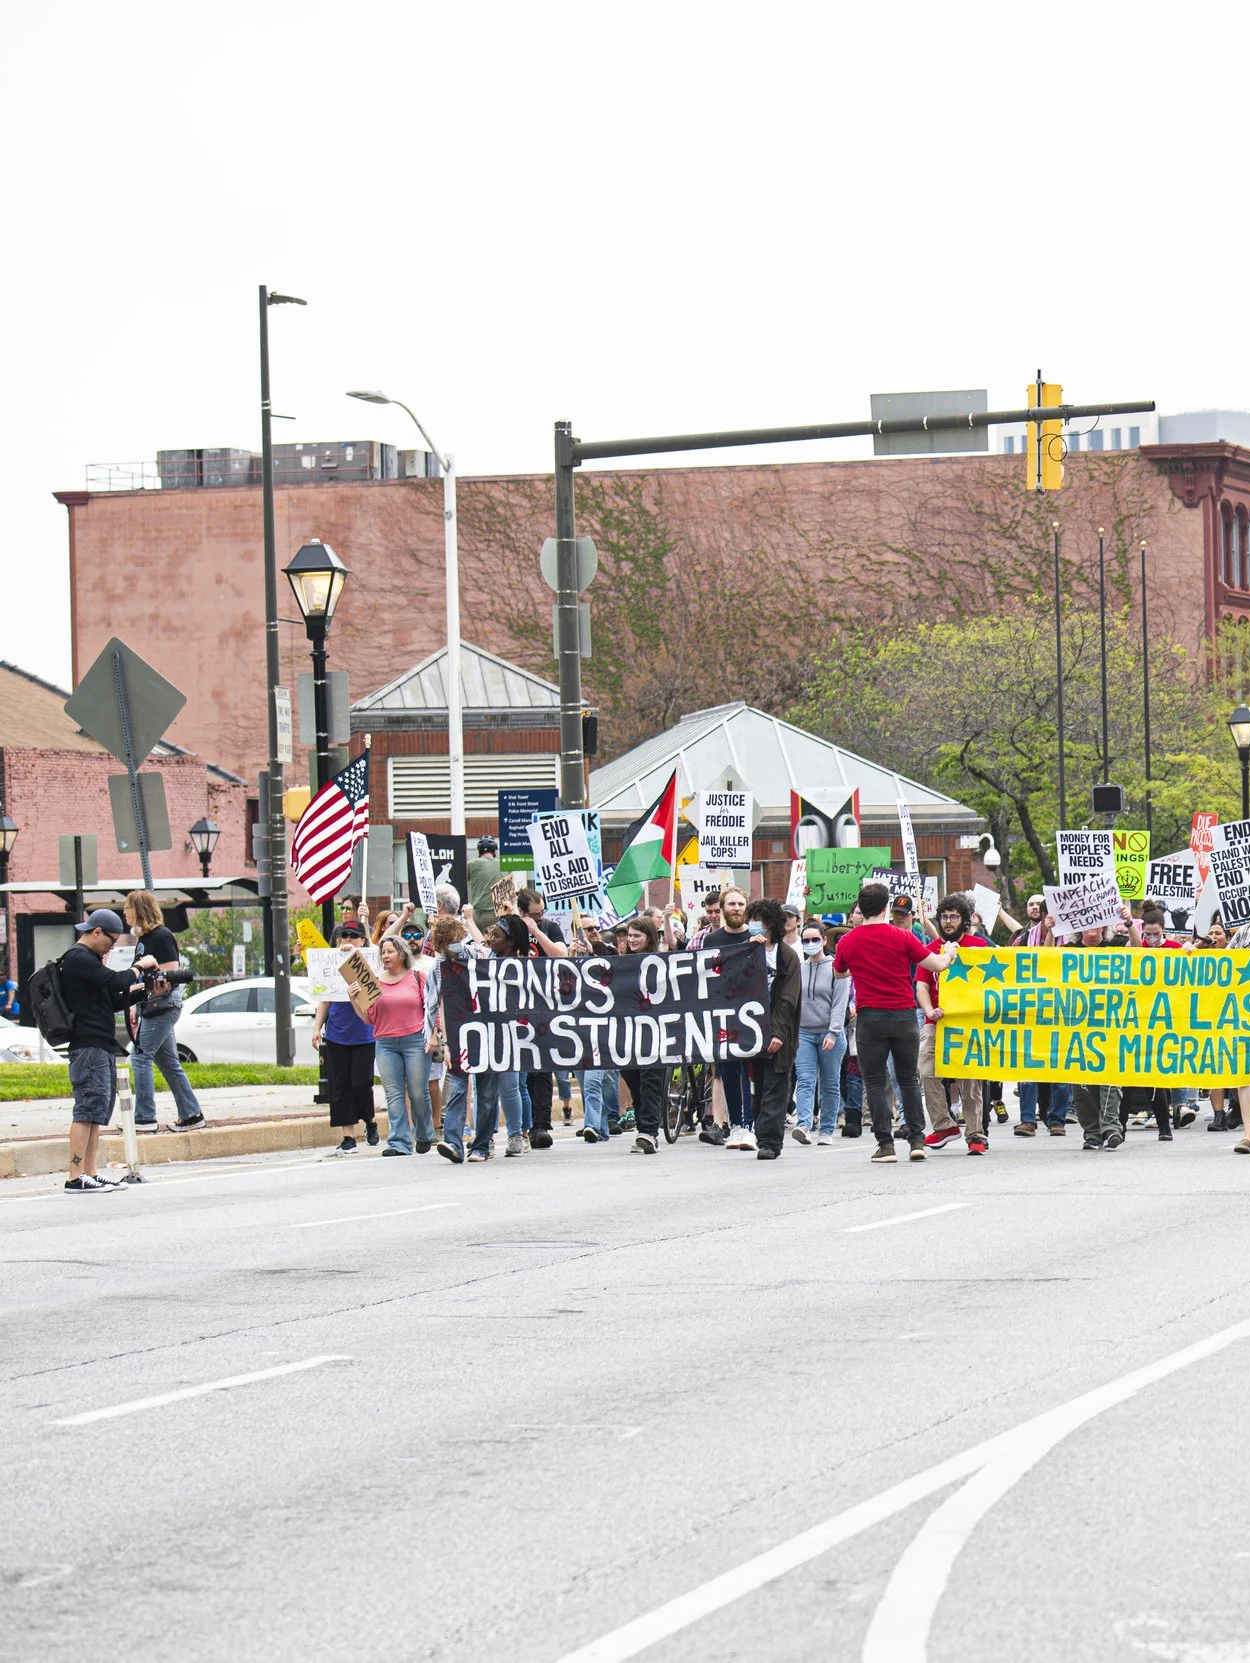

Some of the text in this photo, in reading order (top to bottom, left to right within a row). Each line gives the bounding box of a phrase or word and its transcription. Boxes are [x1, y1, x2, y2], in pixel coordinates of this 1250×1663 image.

[706, 794, 745, 806] JUSTICE
[720, 806, 729, 814] for
[541, 819, 570, 841] END
[705, 815, 745, 827] FREDDIE
[549, 838, 573, 858] ALL
[701, 836, 749, 846] JAIL KILLER
[1060, 833, 1110, 844] MONEY FOR
[711, 847, 737, 857] COPS!
[1061, 843, 1111, 856] PEOPLE'S
[1113, 854, 1148, 862] INGS!
[1210, 847, 1241, 863] STAND
[541, 856, 590, 881] U.S. AID
[810, 850, 872, 881] Liberty
[1069, 856, 1104, 868] NEEDS
[1213, 855, 1250, 875] PALESTI
[544, 881, 557, 894] TO
[558, 872, 594, 891] ISRAEL!
[873, 871, 899, 884] HATE
[1063, 872, 1087, 885] NOT
[1149, 863, 1194, 886] FREE
[1215, 869, 1244, 889] END
[1052, 877, 1106, 904] IMPEACH
[1146, 884, 1195, 898] PALESTINE
[1058, 903, 1101, 922] DEPORT
[1070, 906, 1116, 930] ELON!!!
[348, 954, 382, 1001] MAYDAY!
[1015, 953, 1233, 987] EL PUEBLO UNIDO
[467, 949, 721, 1014] HANDS OFF
[983, 987, 1139, 1029] DEFENDERÁ
[1147, 992, 1174, 1030] A
[459, 1001, 765, 1074] OUR STUDENTS
[942, 1027, 1107, 1073] FAMILIAS
